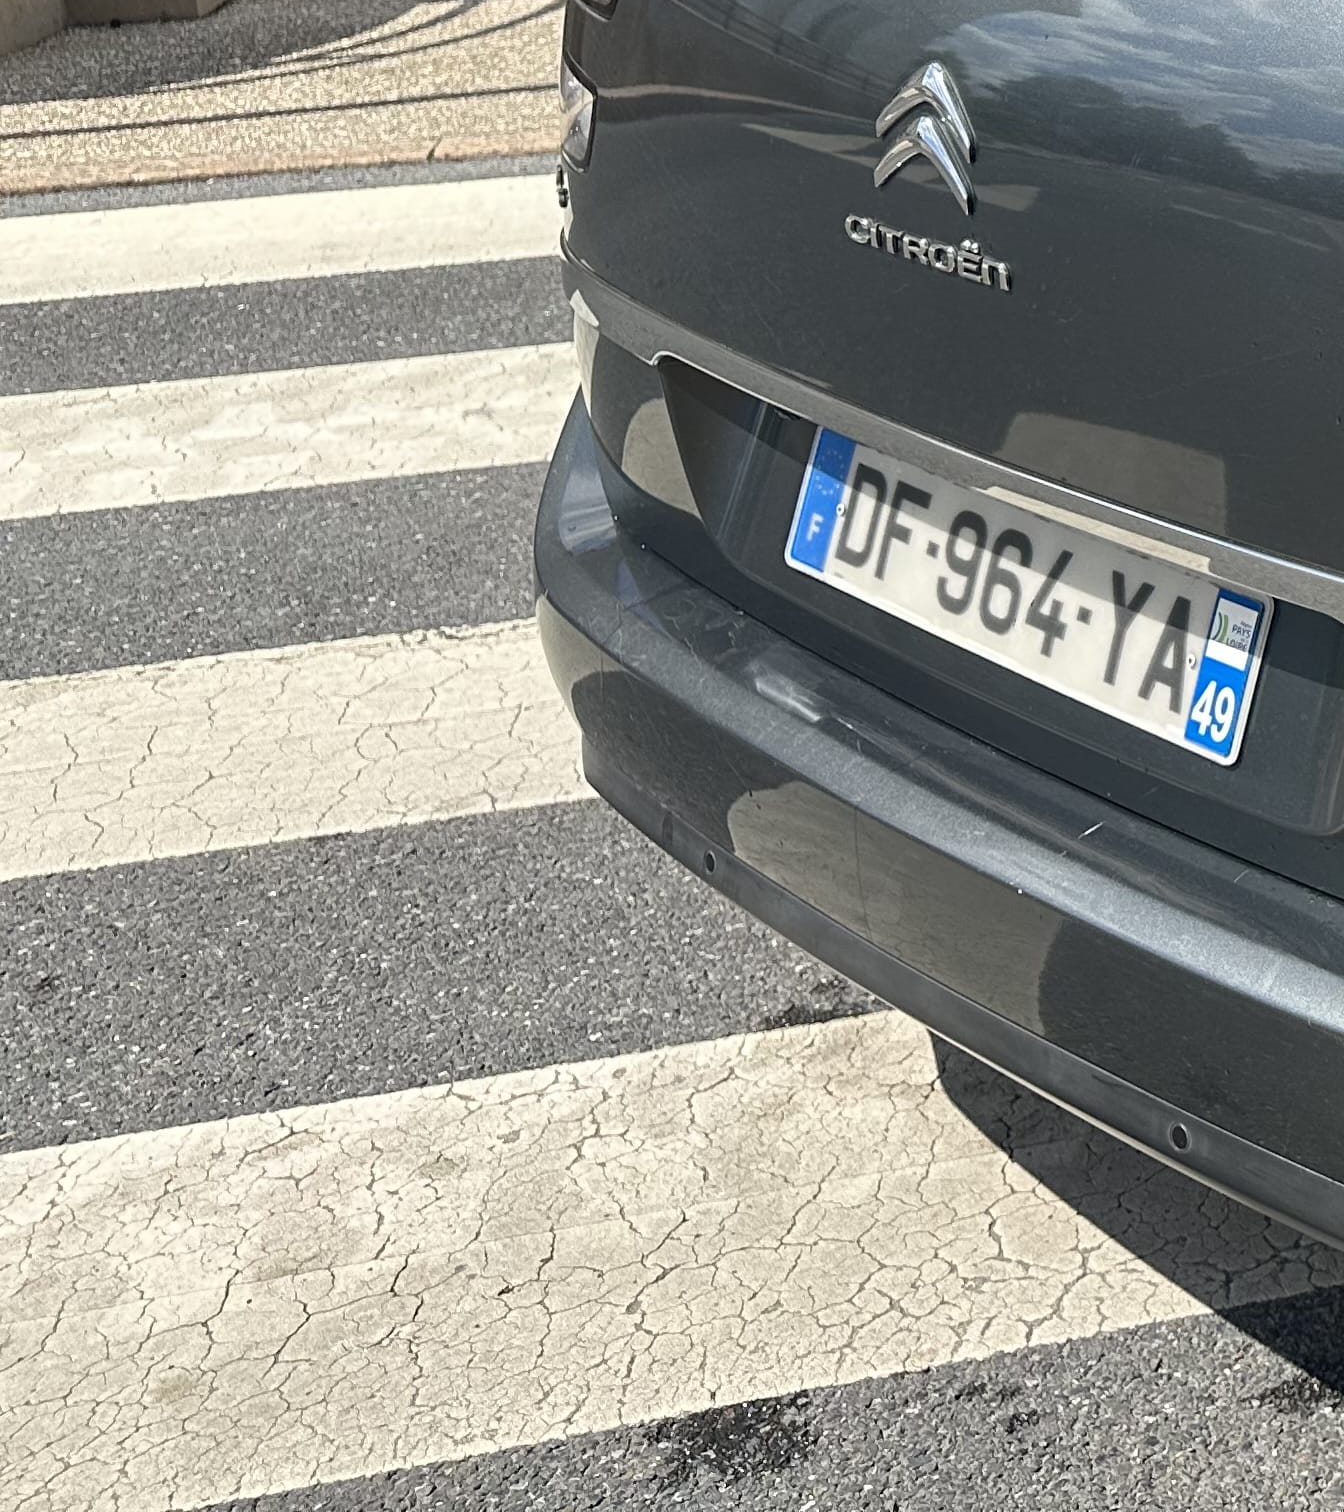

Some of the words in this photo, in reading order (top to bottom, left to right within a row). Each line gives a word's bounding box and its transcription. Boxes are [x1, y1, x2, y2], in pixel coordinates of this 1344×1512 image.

[806, 512, 825, 542] F
[833, 462, 1192, 714] DF-964-YA
[1232, 625, 1252, 638] PAYS
[1191, 680, 1236, 743] 49
